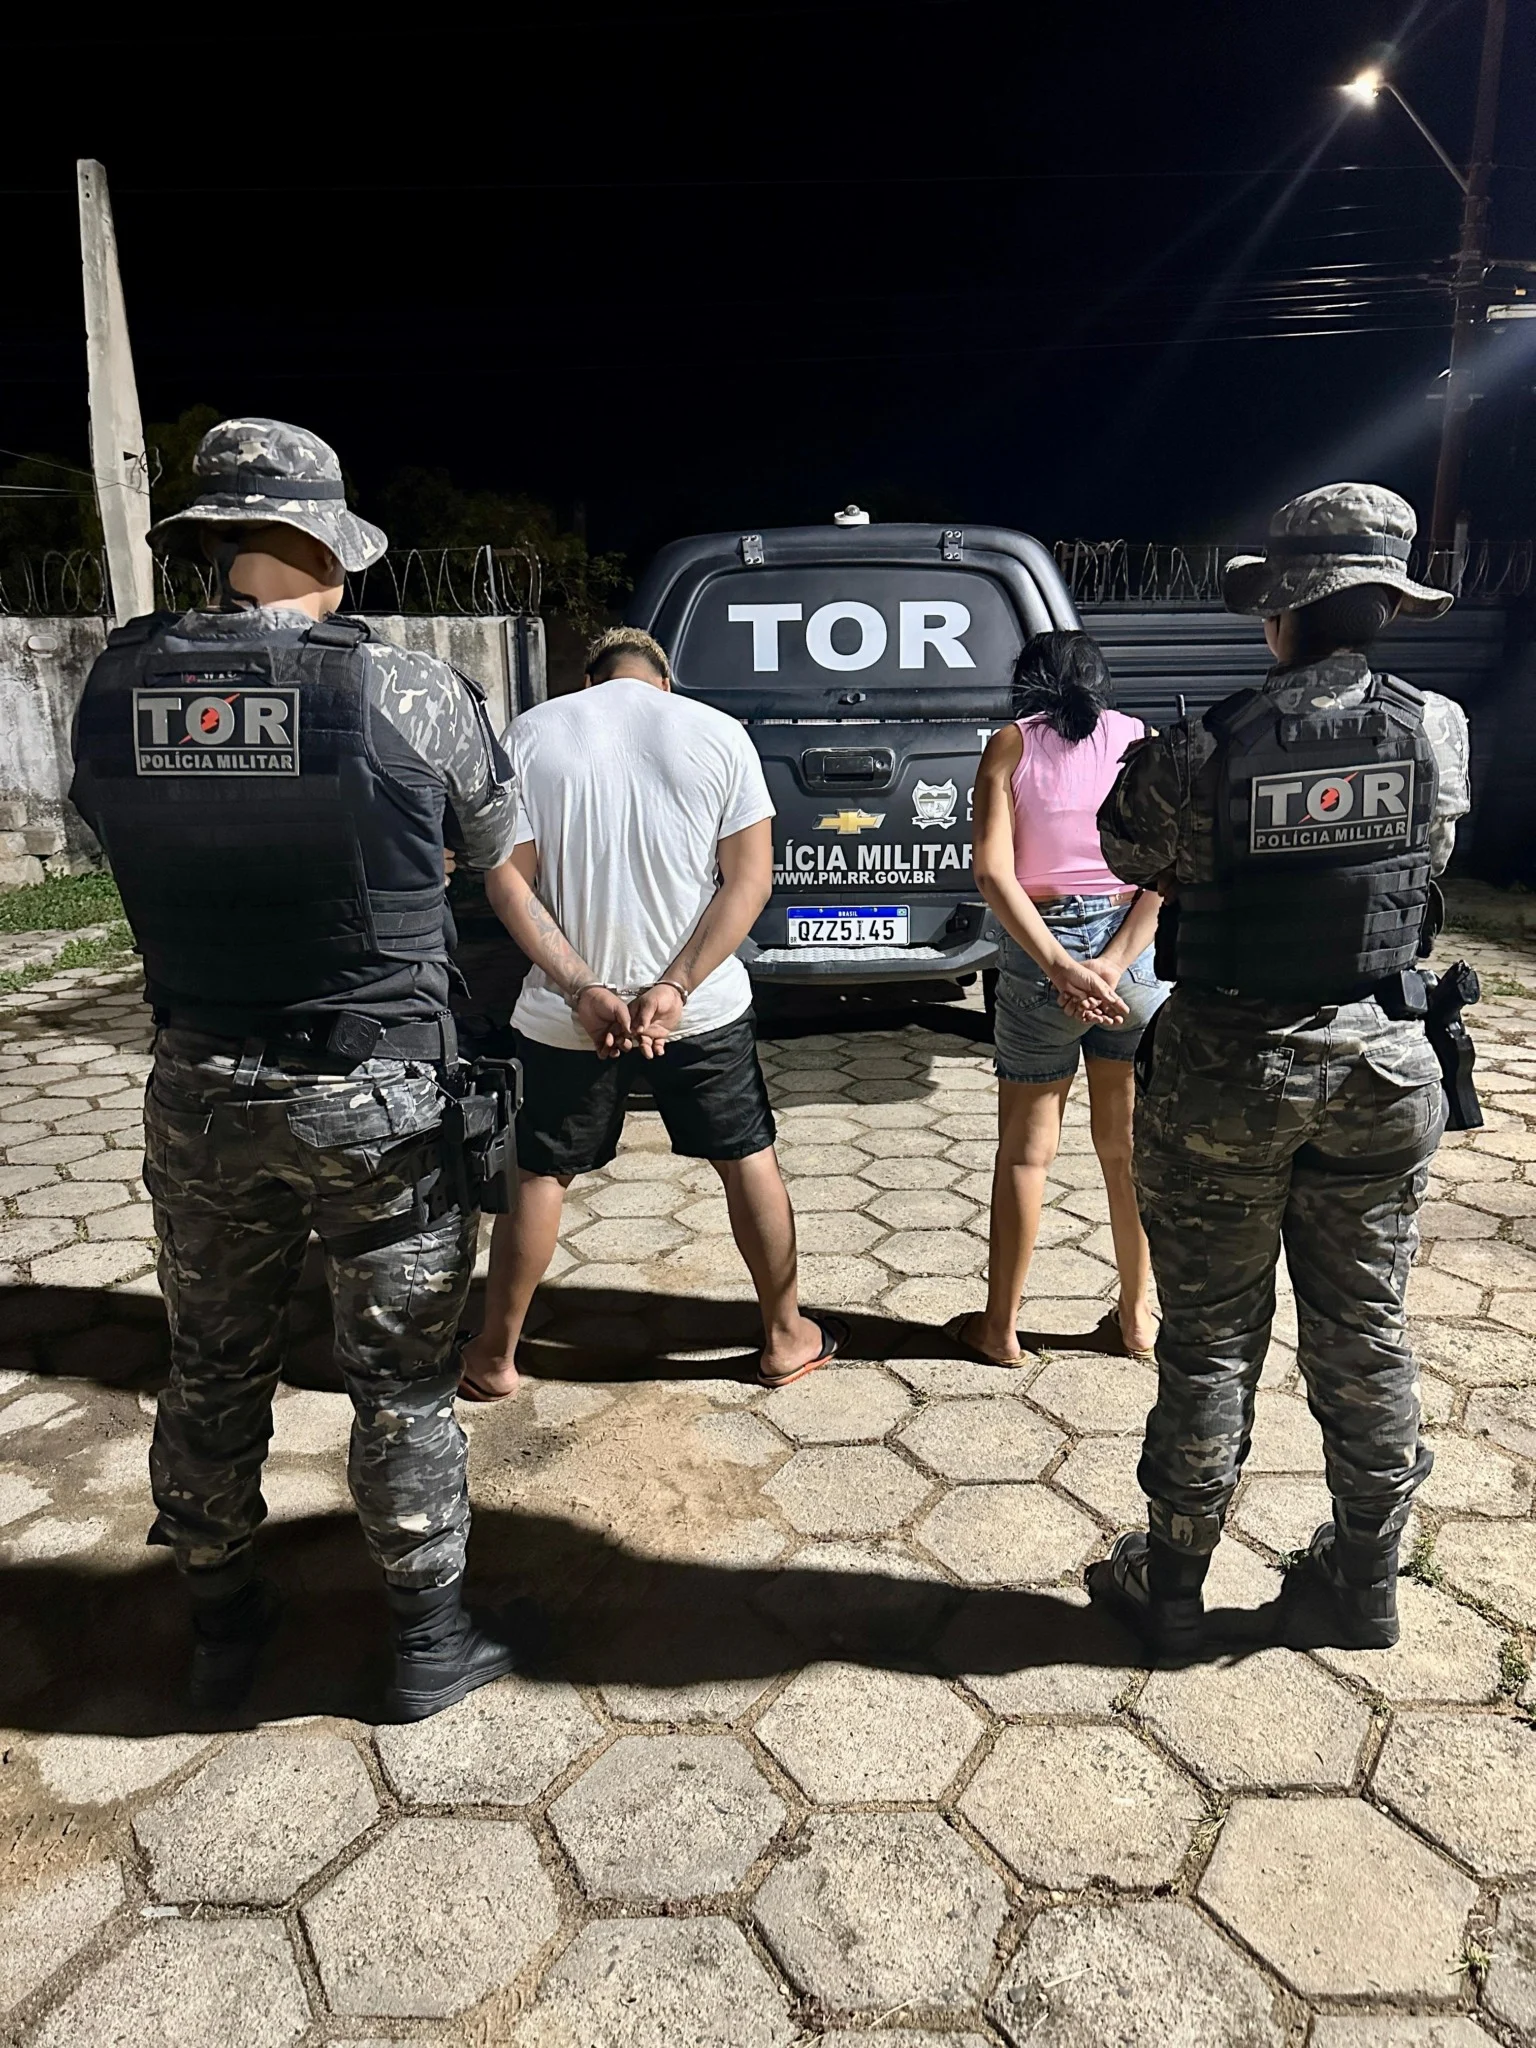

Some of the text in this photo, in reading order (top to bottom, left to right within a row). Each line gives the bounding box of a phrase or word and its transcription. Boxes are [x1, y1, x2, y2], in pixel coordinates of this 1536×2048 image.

[728, 600, 977, 672] TOR
[138, 696, 291, 745] TOR
[141, 751, 293, 770] POLÍCIA MILITAR
[1257, 771, 1407, 827] TOR
[1256, 821, 1406, 848] POLÍCIA MILITAR
[772, 838, 847, 871] LÍCIA
[772, 870, 936, 886] WWW.PM.RR.GOV.BR
